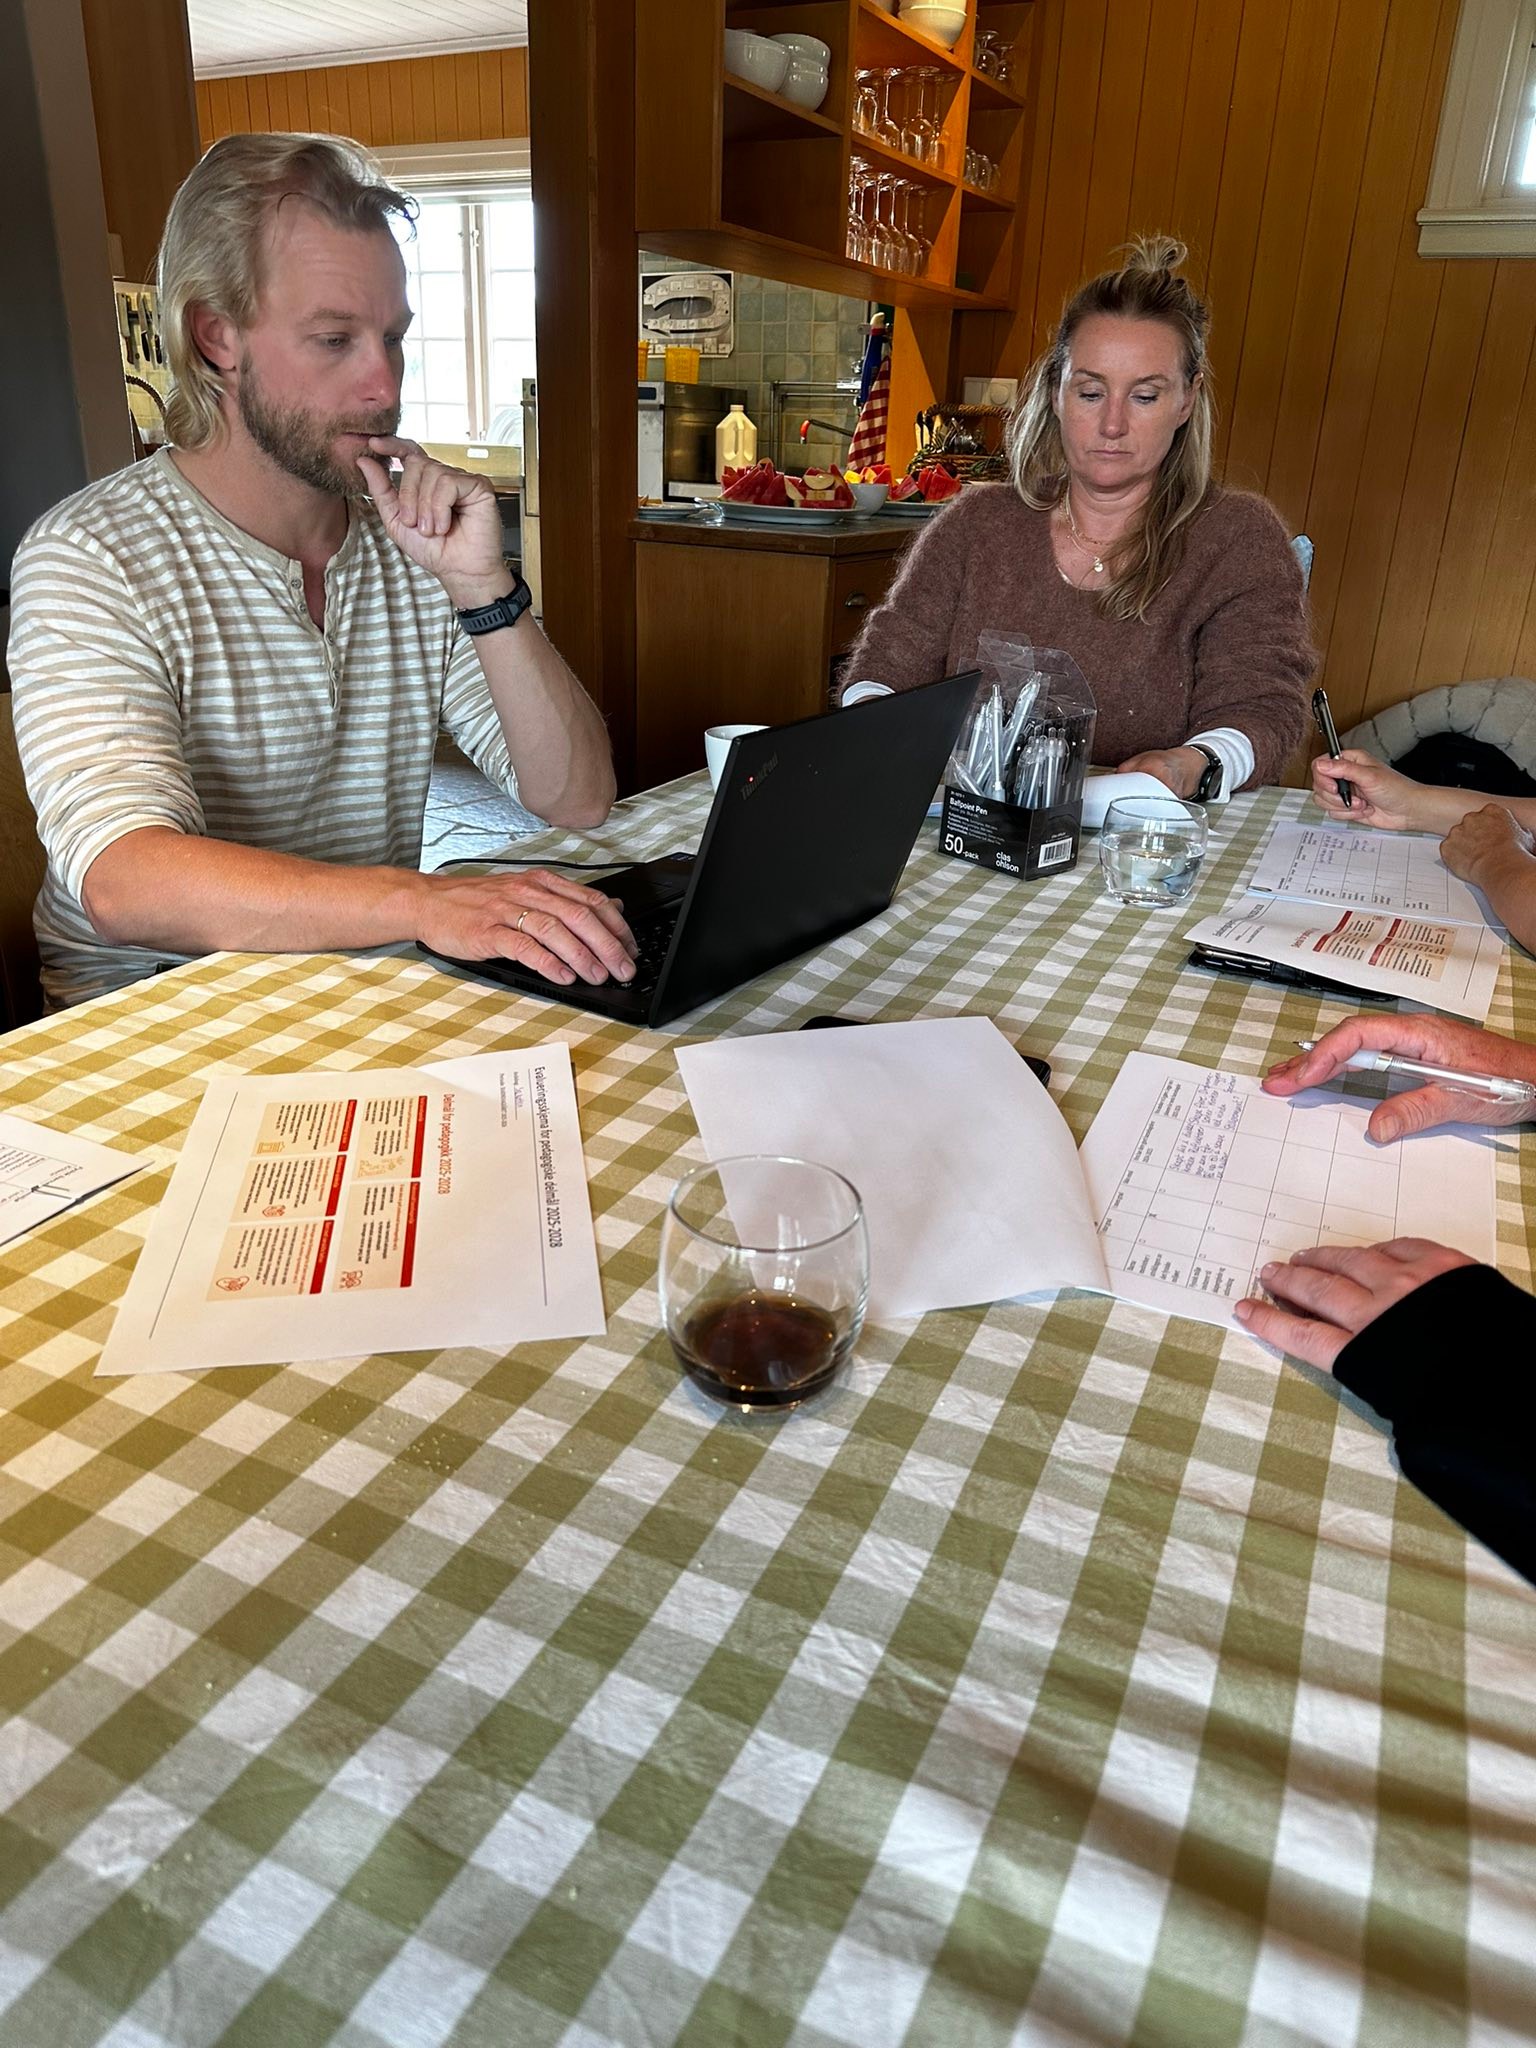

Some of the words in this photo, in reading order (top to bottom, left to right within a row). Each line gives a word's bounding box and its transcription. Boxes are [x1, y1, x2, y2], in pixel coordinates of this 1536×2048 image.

[949, 797, 975, 812] Ballpoint
[975, 806, 988, 816] Pen
[996, 851, 1011, 862] clas
[995, 860, 1019, 873] ohlson
[443, 1094, 455, 1112] Delmål
[442, 1113, 455, 1121] for
[437, 1122, 453, 1157] pedagogikk
[540, 1129, 552, 1139] for
[538, 1140, 556, 1180] pedagogiske
[438, 1158, 452, 1194] 2025-2028
[544, 1181, 560, 1206] delmål
[546, 1207, 563, 1248] 2025-2028
